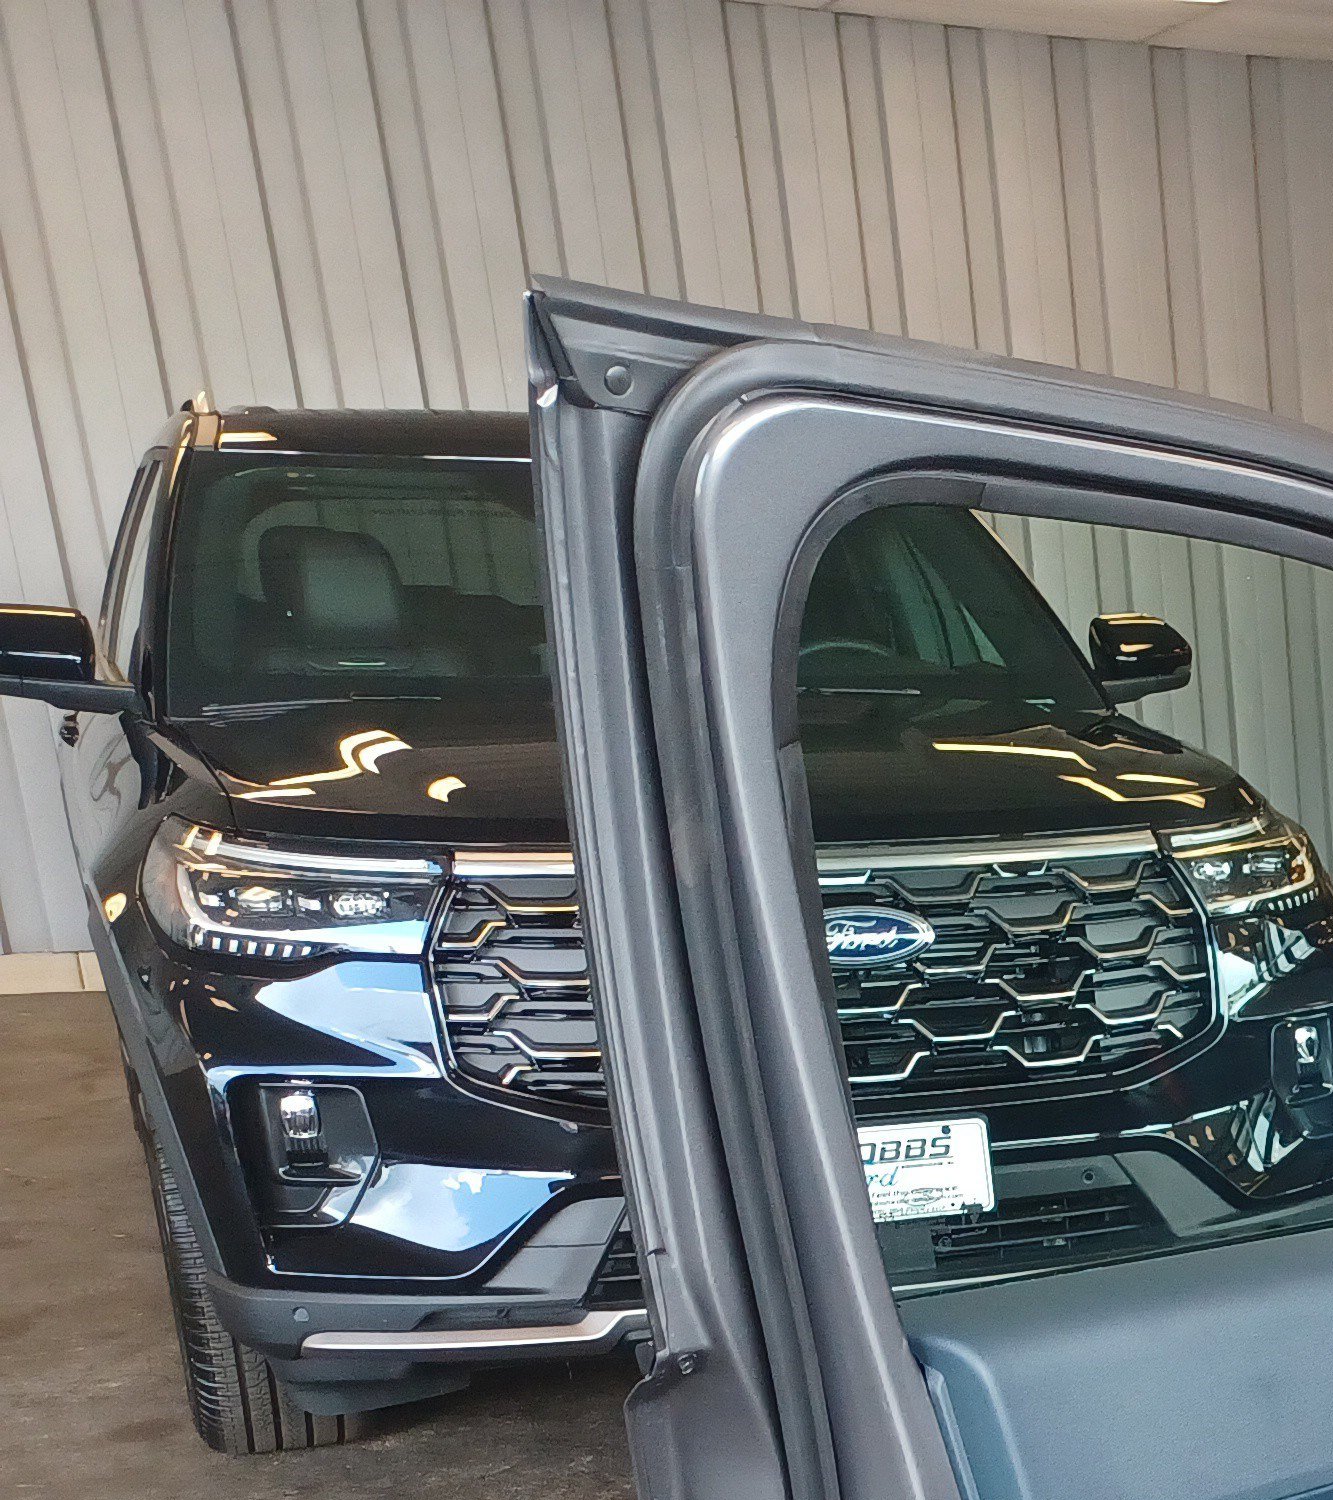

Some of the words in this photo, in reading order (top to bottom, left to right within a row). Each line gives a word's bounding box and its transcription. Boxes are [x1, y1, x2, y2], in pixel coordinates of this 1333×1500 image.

[826, 919, 899, 953] Ford
[861, 1136, 951, 1163] OBBS
[866, 1165, 900, 1187] rd
